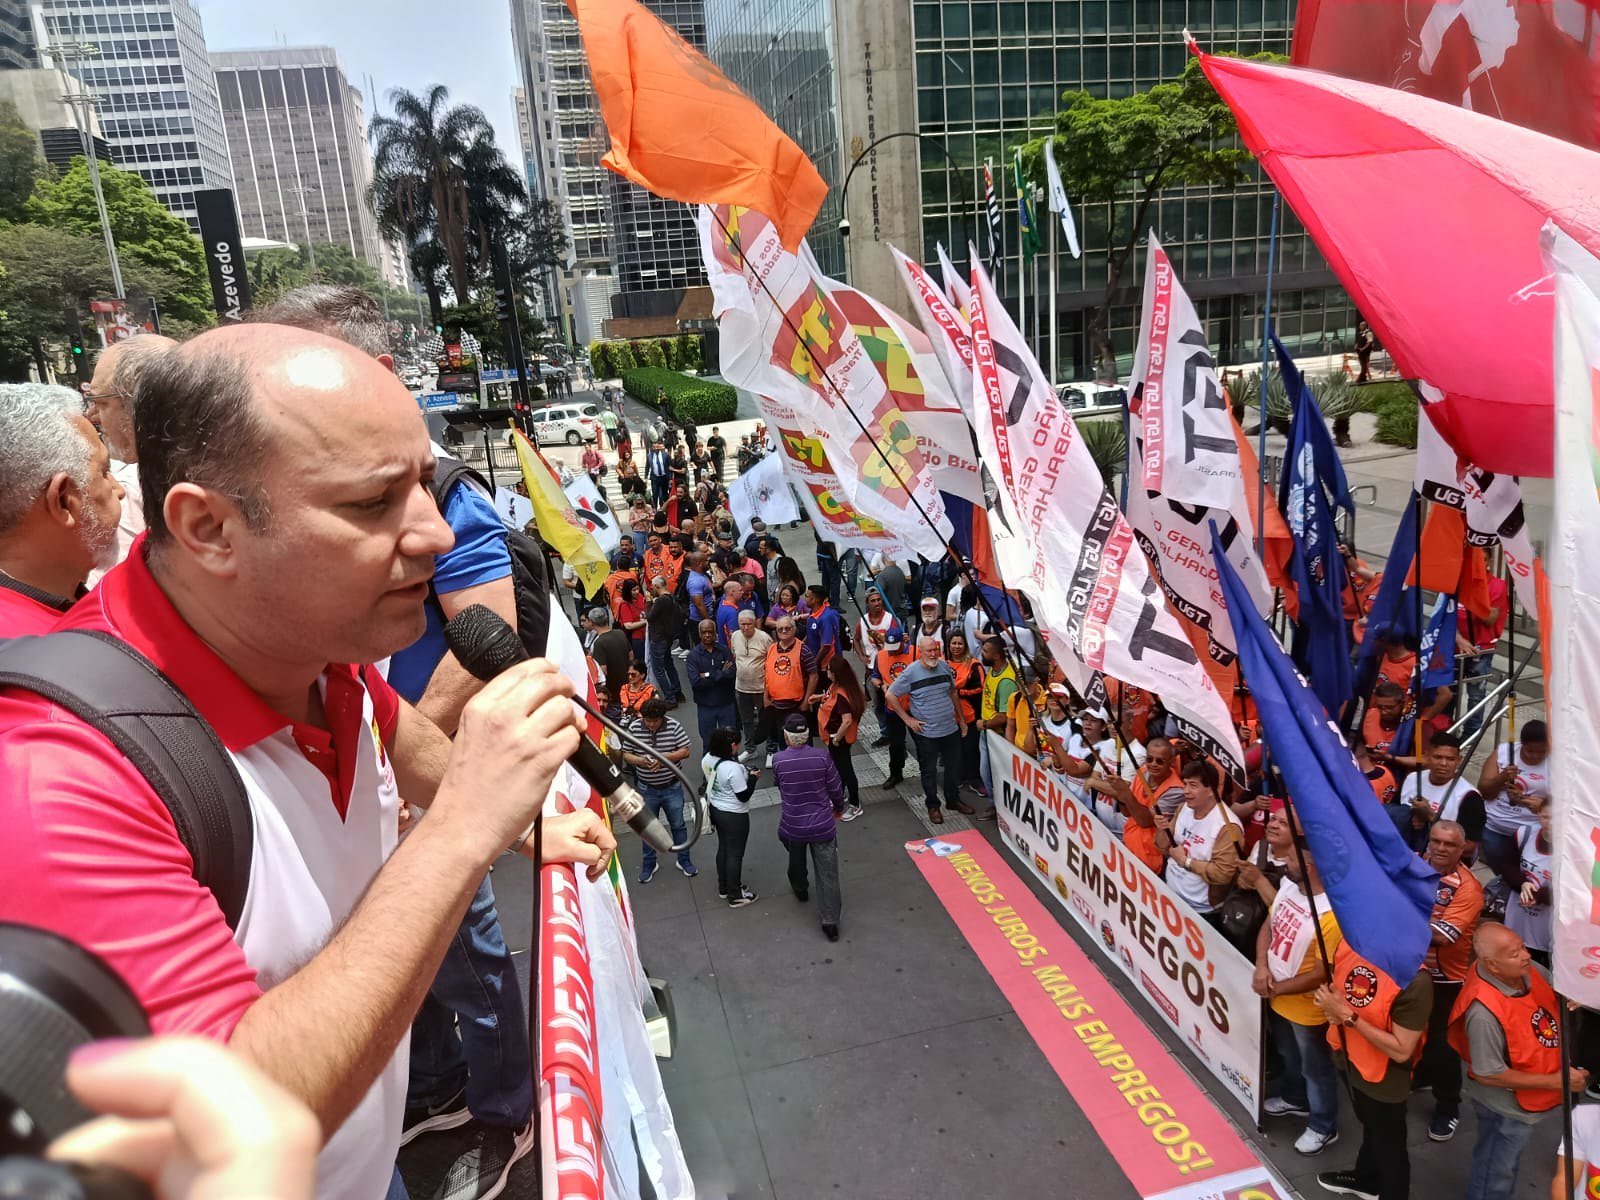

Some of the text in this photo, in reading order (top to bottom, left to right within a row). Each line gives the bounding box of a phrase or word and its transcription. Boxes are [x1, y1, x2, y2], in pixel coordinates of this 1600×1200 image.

[865, 42, 880, 242] TRIBUNAL REGIONAL FEDERAL
[214, 241, 243, 321] Azevedo
[930, 300, 959, 333] UGT
[974, 330, 995, 370] UGT
[986, 376, 1004, 419] UGT
[995, 424, 1011, 468] UGT
[947, 454, 979, 473] Bra
[1178, 602, 1207, 625] UGT
[1208, 641, 1229, 661] GT
[1176, 719, 1241, 775] UGT UGT
[1003, 781, 1230, 1035] MAIS EMPREGOS
[1012, 753, 1215, 981] MENOS JUROS,
[946, 852, 1005, 905] MENOS
[985, 905, 1048, 967] JUROS,
[1032, 964, 1095, 1021] MAIS
[1073, 1019, 1215, 1176] EMPREGOS!
